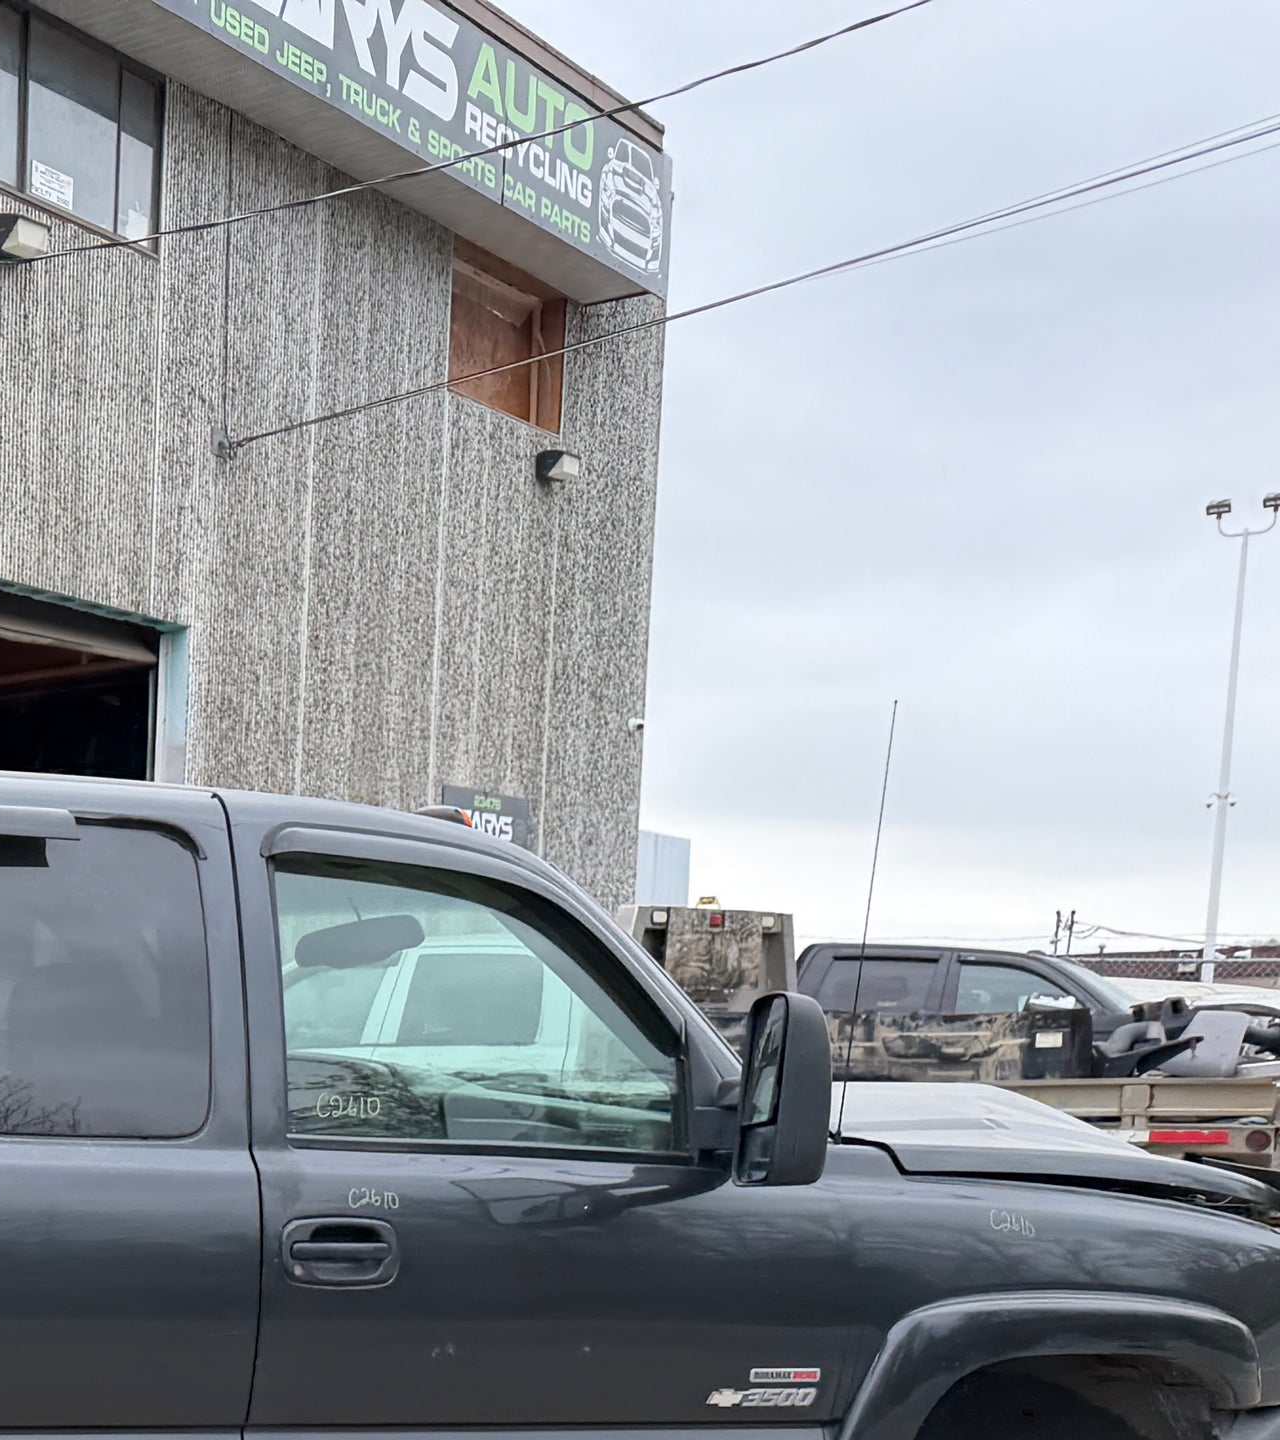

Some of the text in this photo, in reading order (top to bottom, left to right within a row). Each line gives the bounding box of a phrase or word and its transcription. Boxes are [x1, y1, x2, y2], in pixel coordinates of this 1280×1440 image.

[210, 0, 590, 243] USED JEEP, TRUCK & SPORTS CAR PARTS
[467, 42, 594, 171] AUTO
[464, 101, 592, 208] RECYCLING
[463, 809, 513, 841] ARYS
[316, 1092, 380, 1119] C2610
[348, 1188, 399, 1210] C2610
[742, 1388, 817, 1407] 3500
